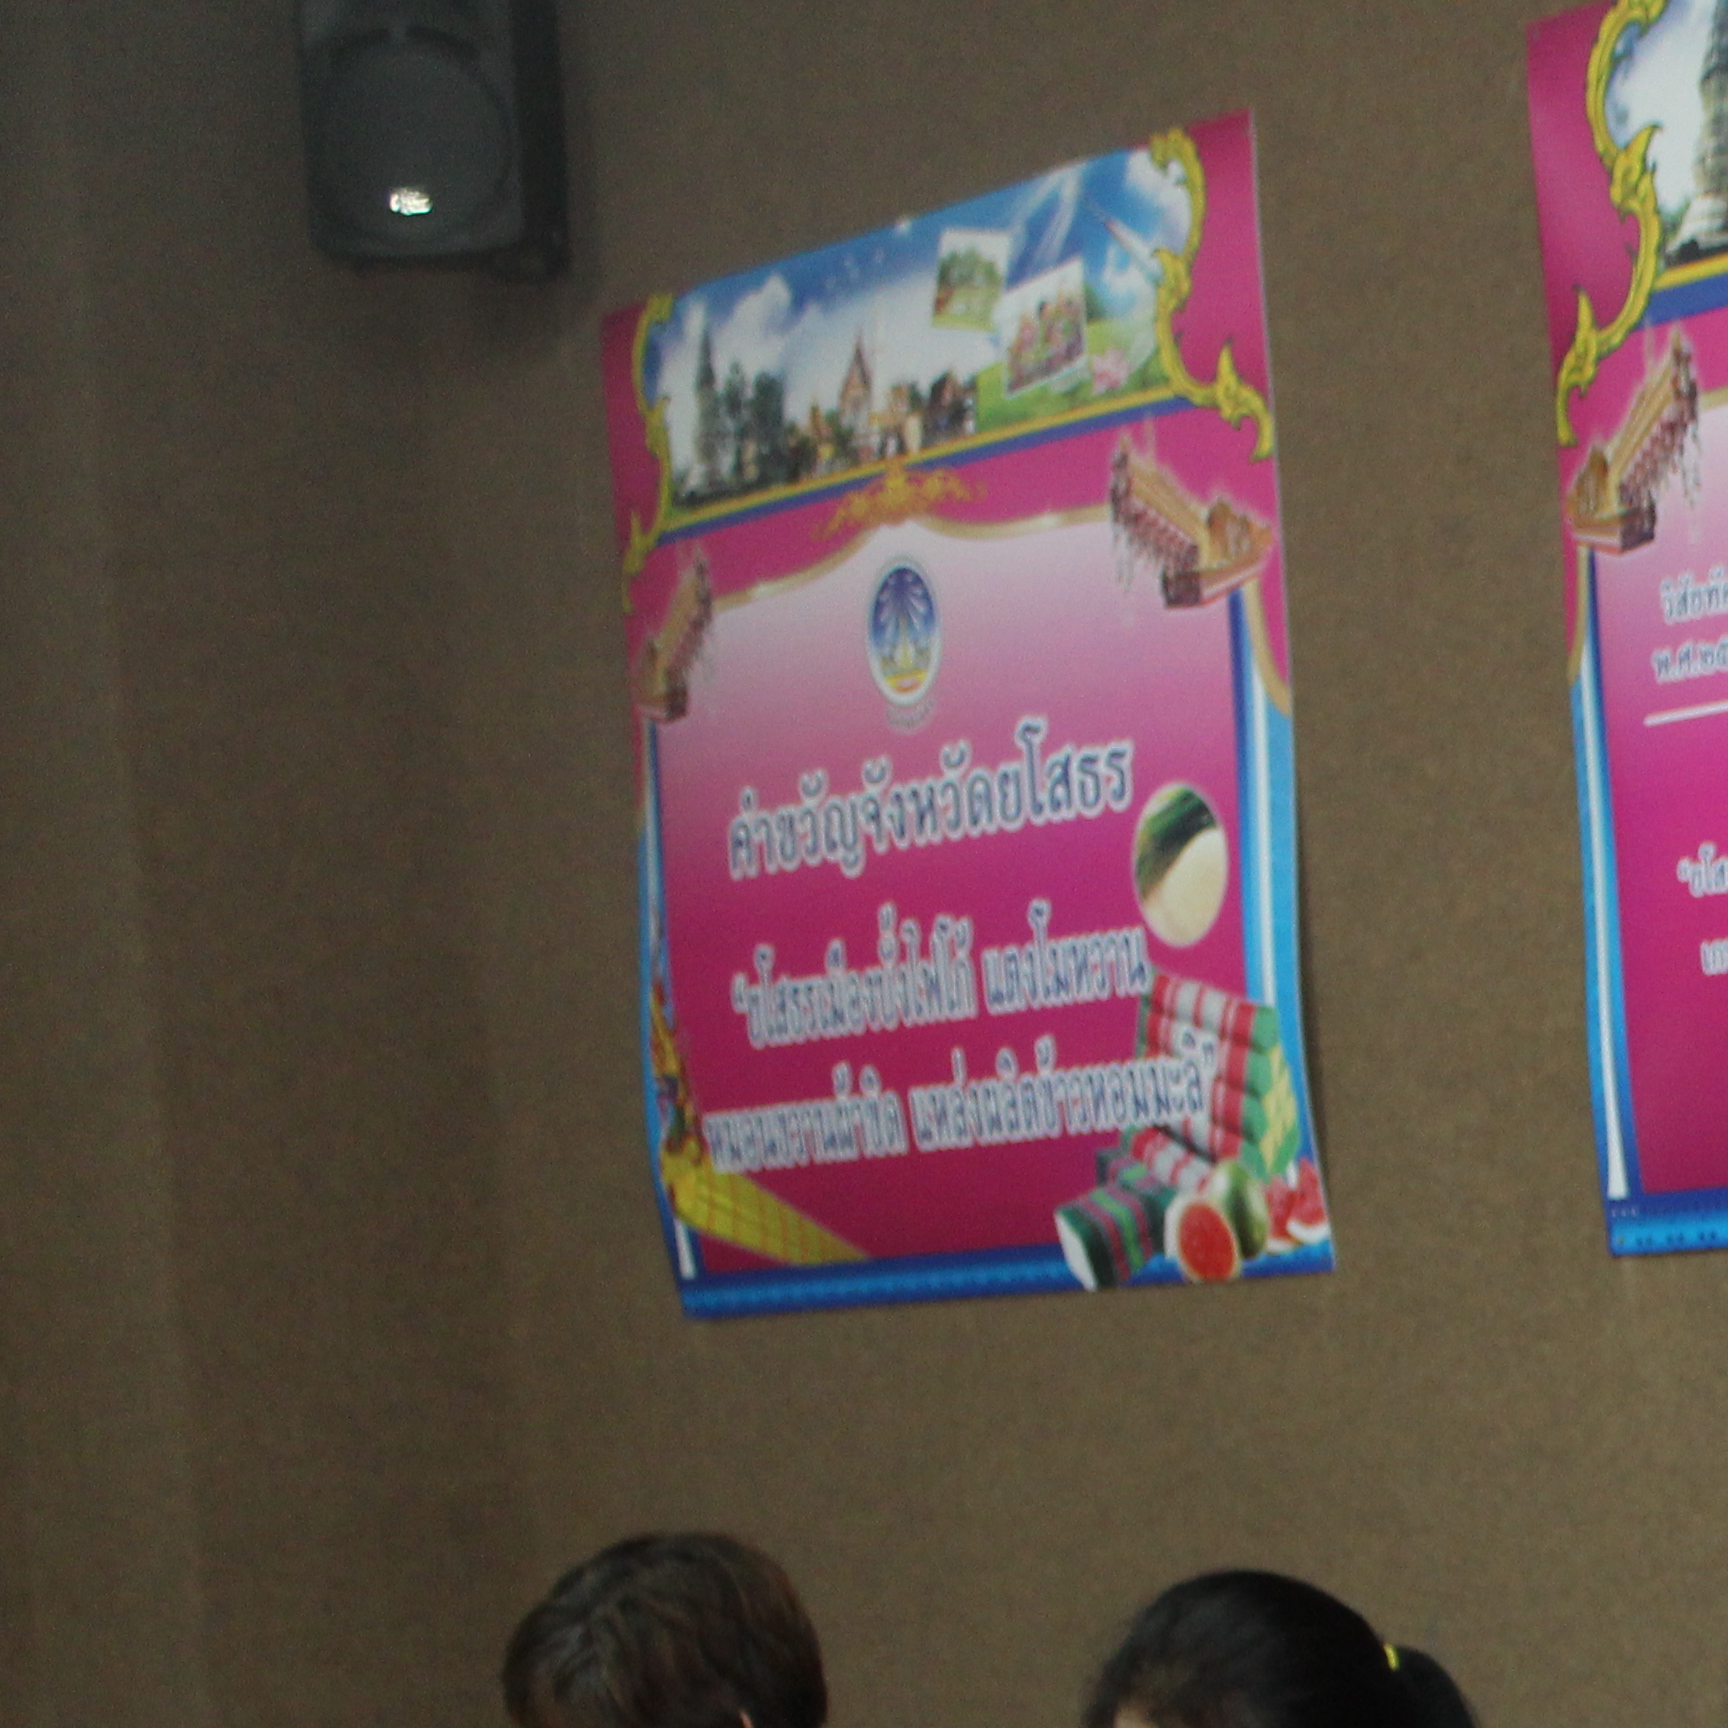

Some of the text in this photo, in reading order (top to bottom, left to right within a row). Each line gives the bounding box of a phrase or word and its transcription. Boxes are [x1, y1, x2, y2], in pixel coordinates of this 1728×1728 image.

[728, 715, 1133, 879] คำขวัญจังหวัดยโสธร
